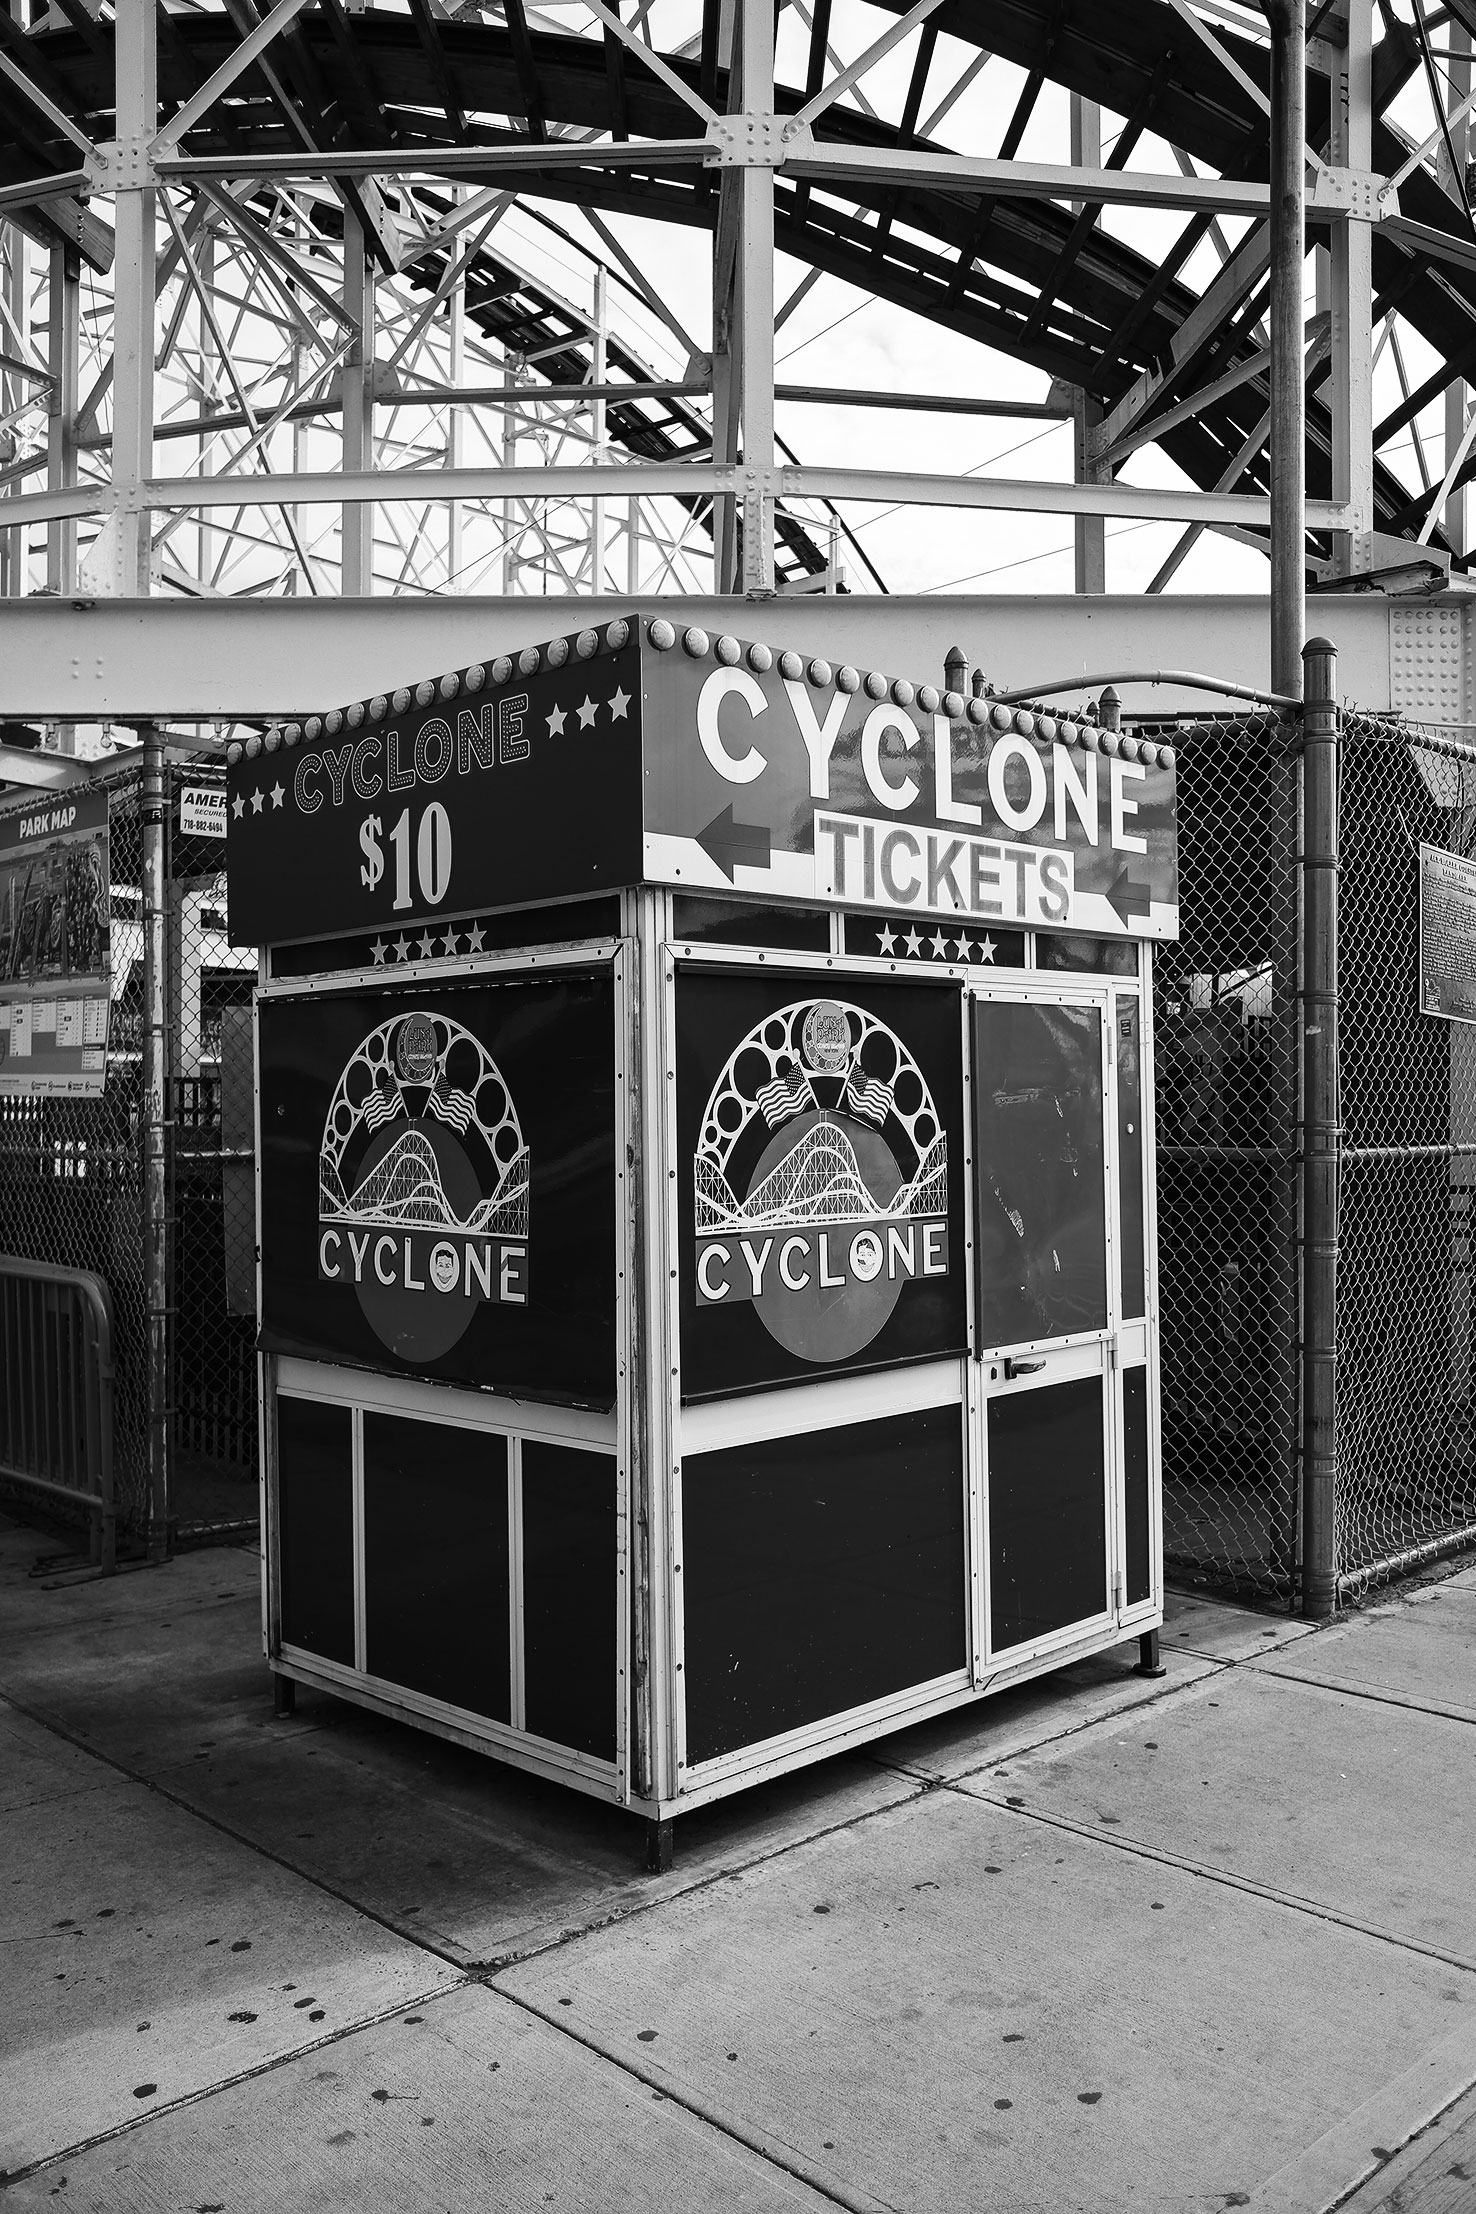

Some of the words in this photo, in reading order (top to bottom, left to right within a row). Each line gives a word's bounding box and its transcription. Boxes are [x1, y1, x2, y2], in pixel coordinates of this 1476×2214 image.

[294, 693, 531, 814] CYCLONE
[696, 665, 1149, 855] CYCLONE
[19, 813, 50, 839] PARK
[51, 806, 77, 831] MAP
[183, 818, 223, 833] 718-882-6494
[358, 801, 452, 910] $10
[818, 817, 1072, 923] TICKETS
[318, 1228, 527, 1304] CYCLONE
[696, 1221, 949, 1301] CYCLONE
